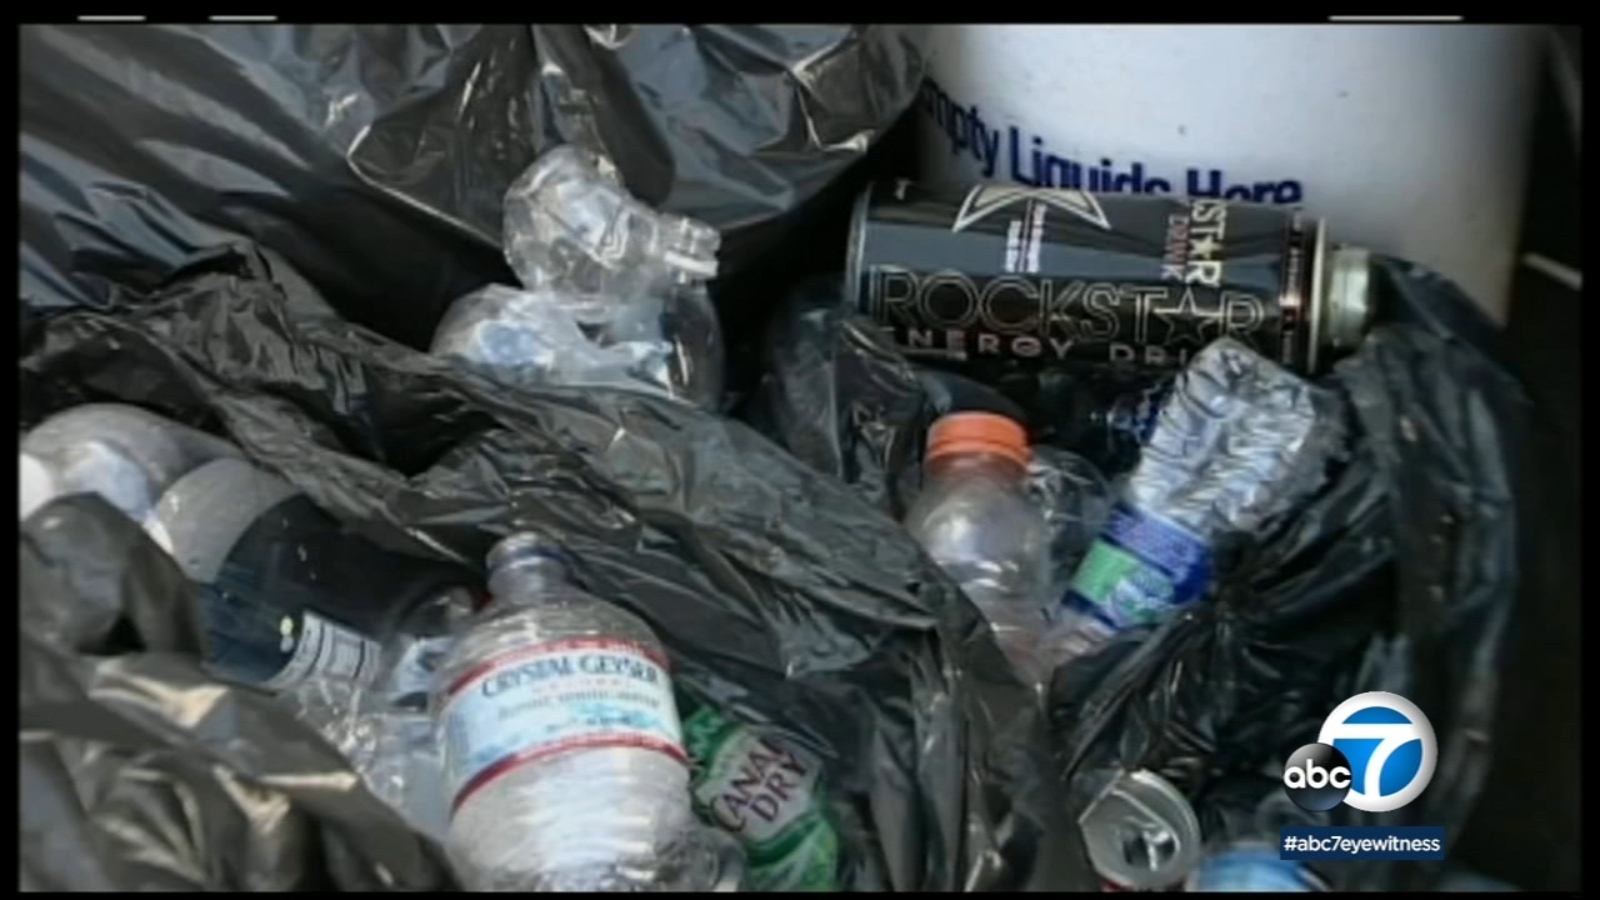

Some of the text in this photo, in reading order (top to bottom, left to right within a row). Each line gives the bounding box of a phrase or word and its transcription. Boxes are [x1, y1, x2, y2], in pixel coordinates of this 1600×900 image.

[921, 75, 999, 179] mpty
[880, 326, 1074, 359] NERGY
[482, 656, 574, 697] CRYSTAL
[750, 751, 806, 822] DRY
